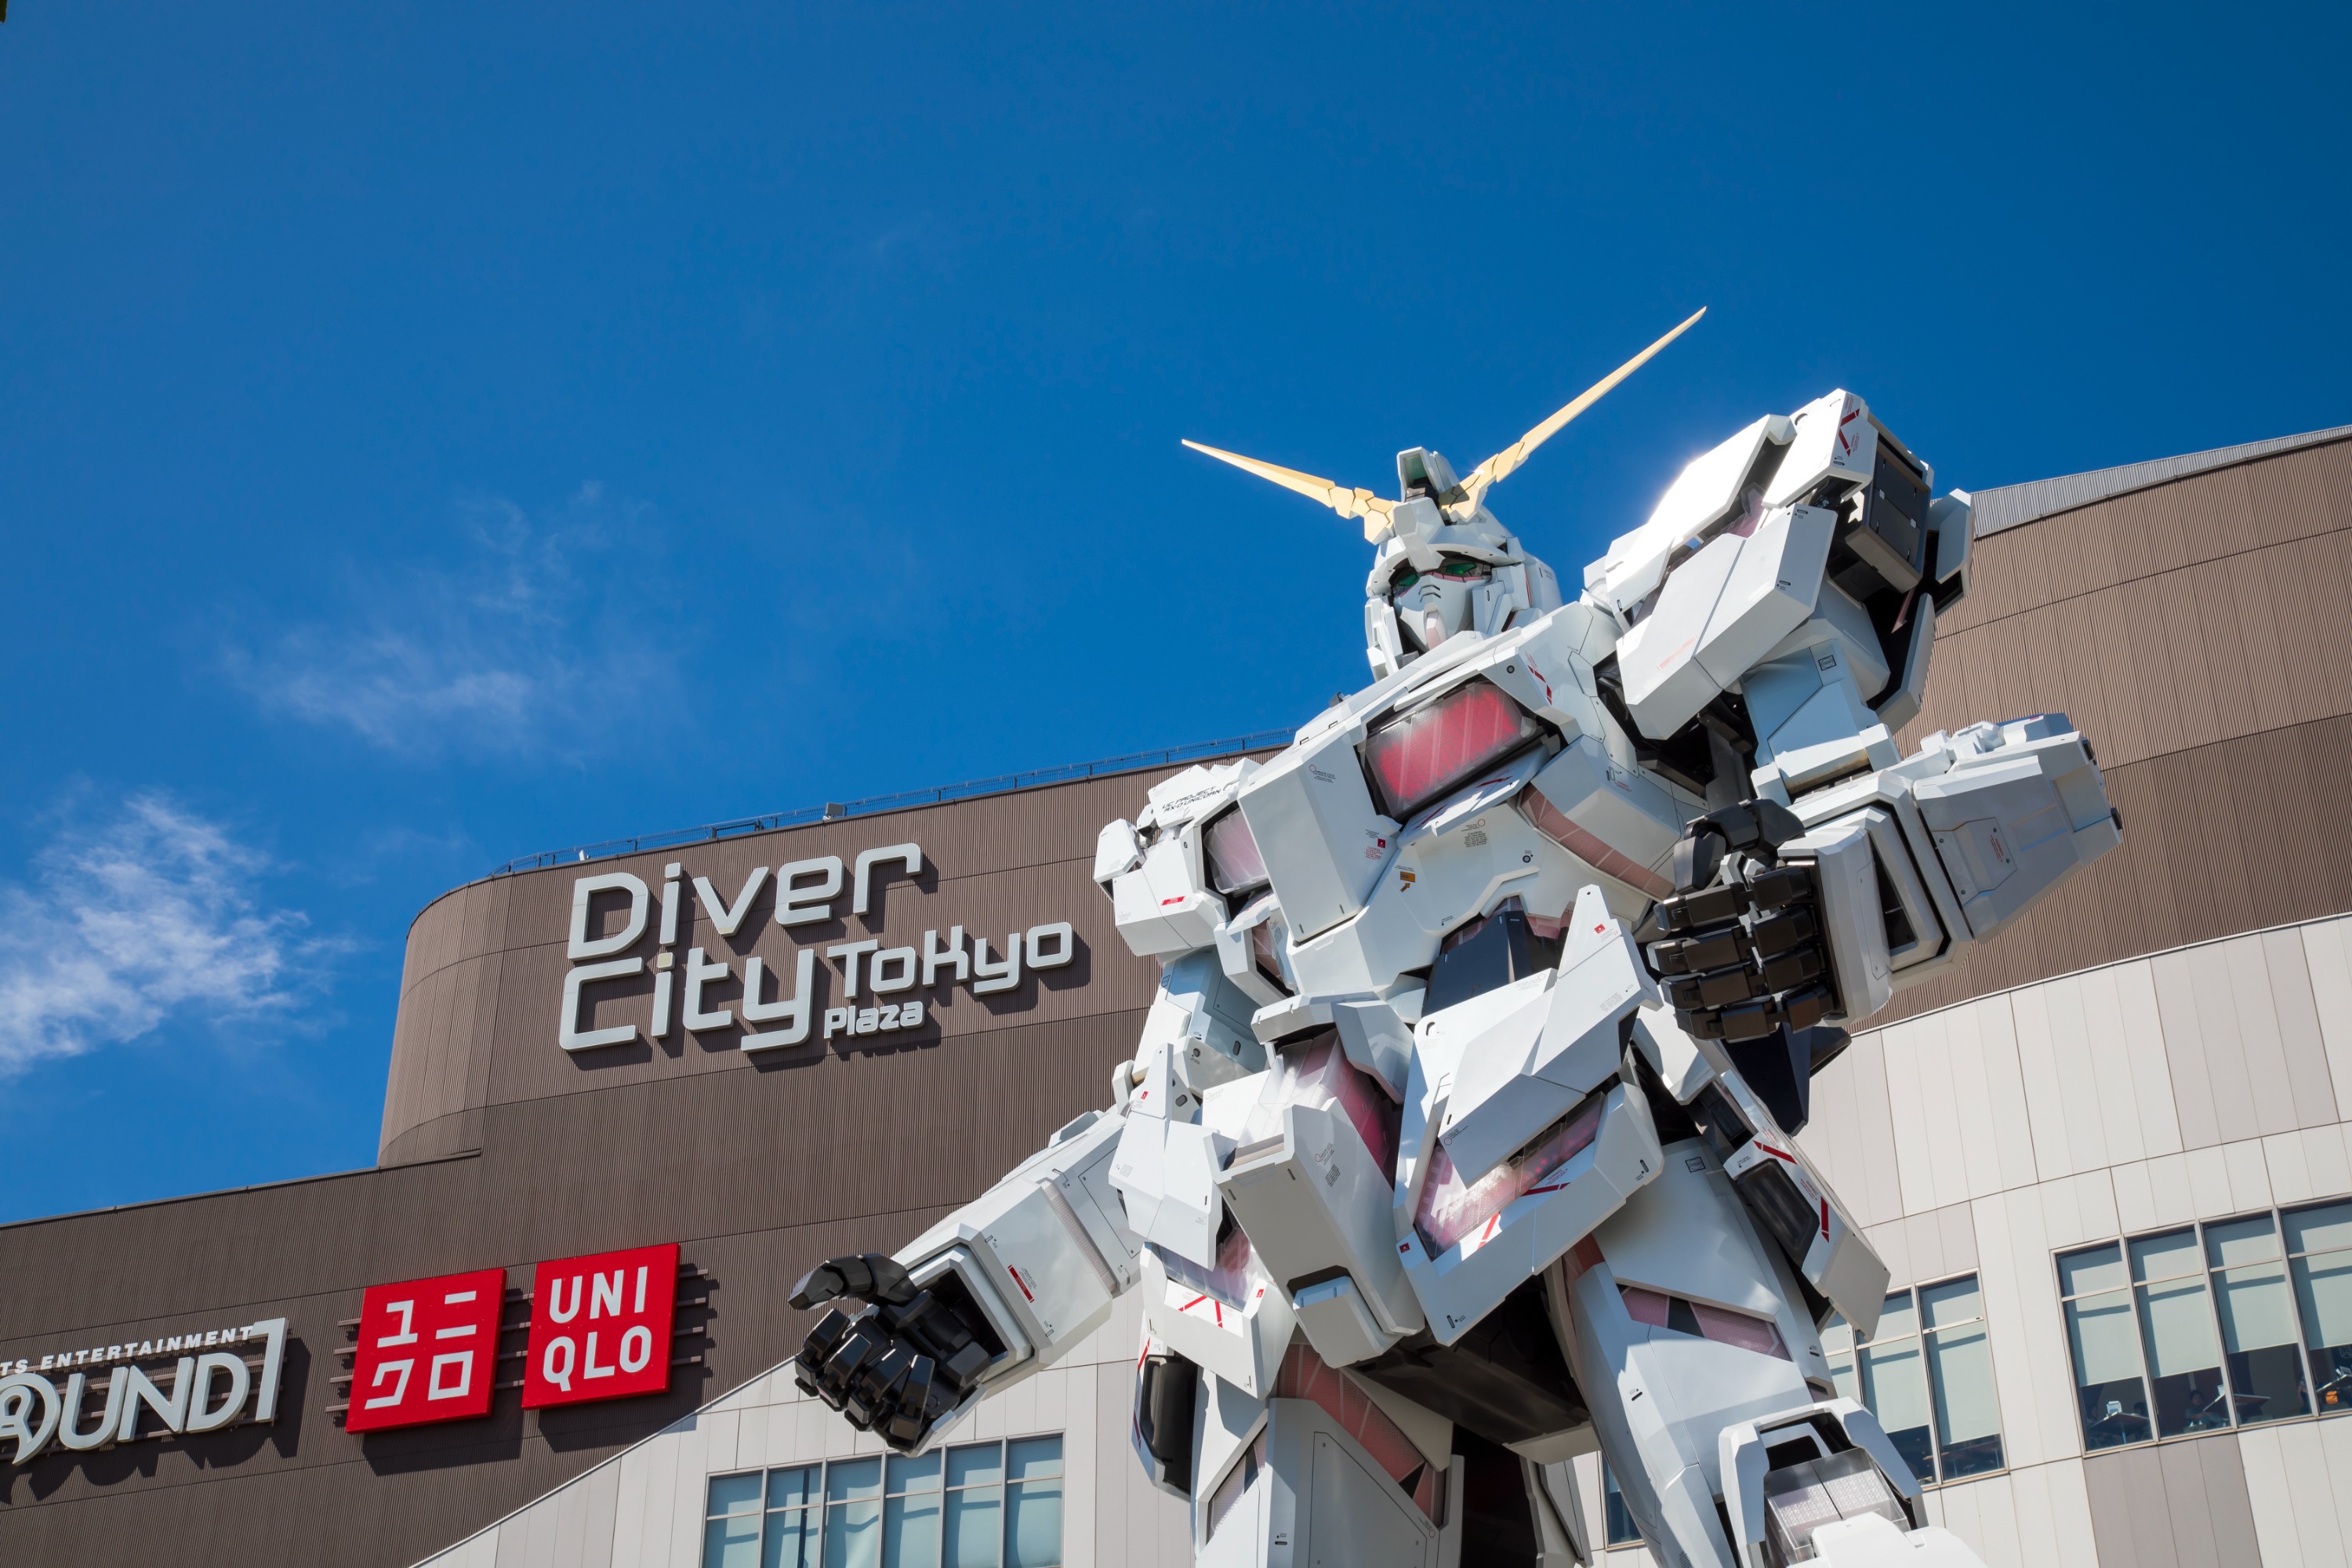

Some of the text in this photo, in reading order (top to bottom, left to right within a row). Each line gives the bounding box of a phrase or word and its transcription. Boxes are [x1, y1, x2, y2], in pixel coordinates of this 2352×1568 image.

[1175, 786, 1216, 804] PROJECT
[1184, 789, 1221, 806] UNICORN
[568, 843, 923, 962] Diver
[558, 947, 816, 1053] City
[549, 1265, 648, 1324] UNI
[0, 1325, 254, 1376] TS ENTERTAINMENT
[543, 1325, 652, 1392] QLO
